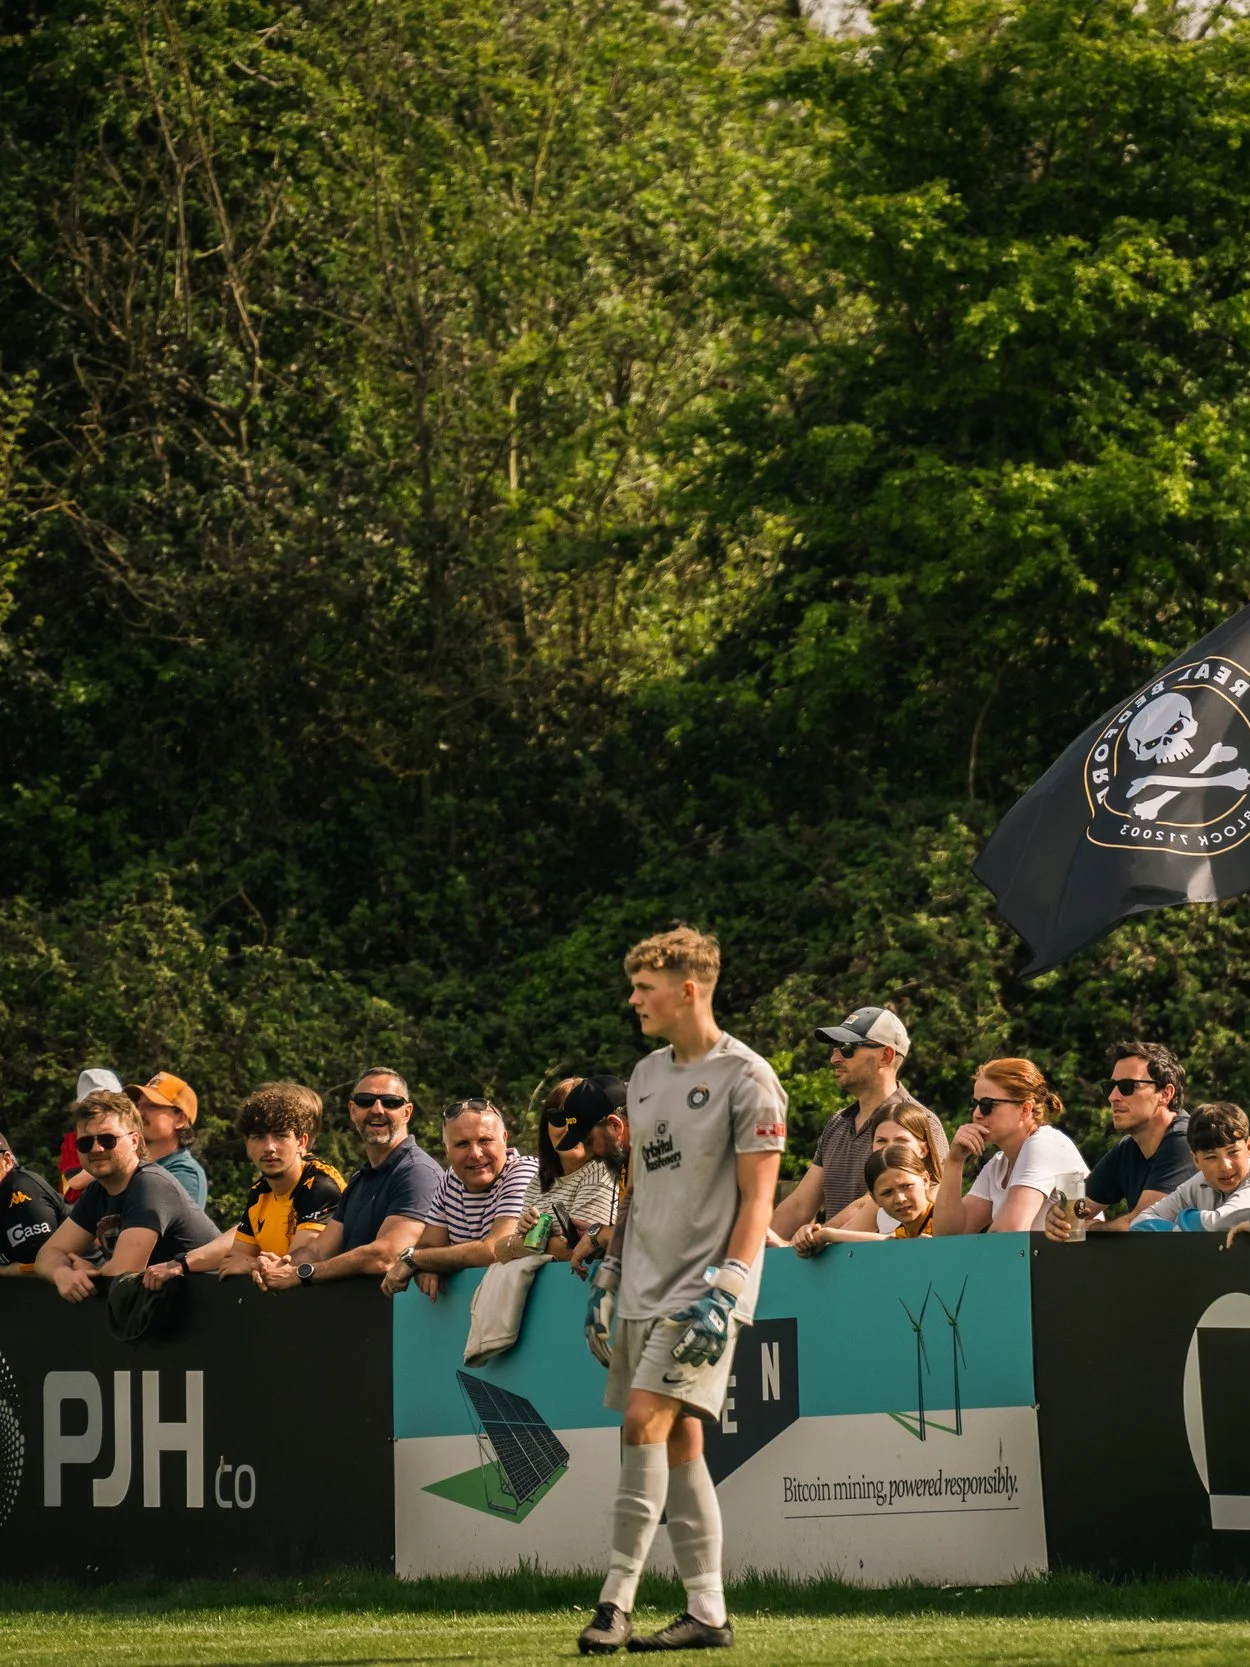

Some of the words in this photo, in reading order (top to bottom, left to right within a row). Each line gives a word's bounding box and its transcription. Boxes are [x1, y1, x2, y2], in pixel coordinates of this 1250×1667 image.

[6, 1222, 52, 1248] Casa
[43, 1370, 204, 1508] PJH
[214, 1463, 256, 1509] co
[783, 1476, 831, 1502] Bitcoin
[833, 1474, 887, 1506] mining,
[888, 1469, 943, 1505] powered
[944, 1466, 1019, 1502] responsibly.
